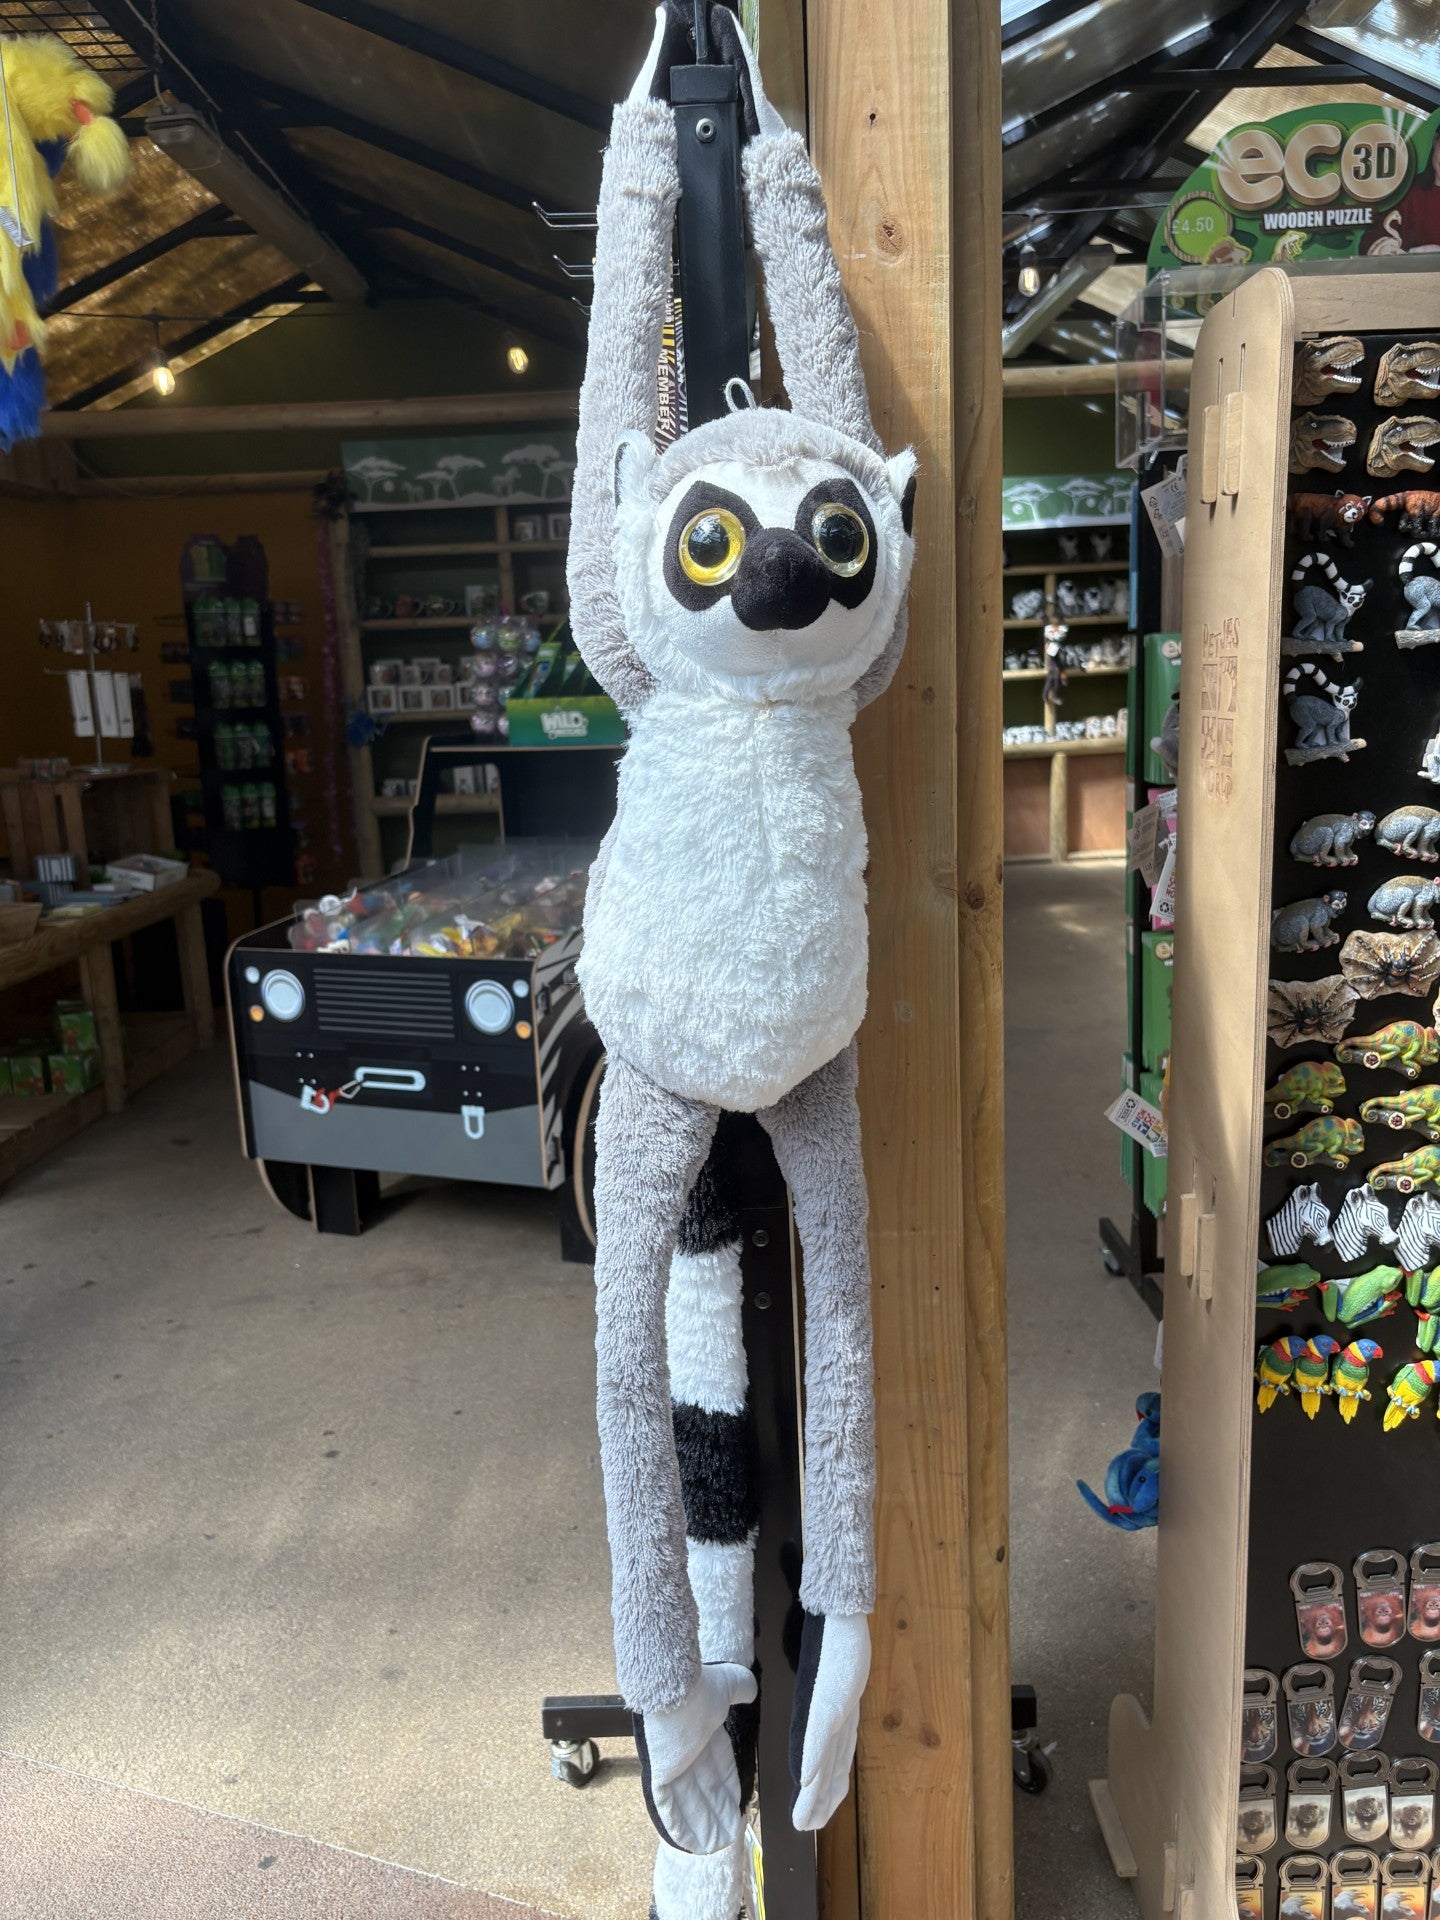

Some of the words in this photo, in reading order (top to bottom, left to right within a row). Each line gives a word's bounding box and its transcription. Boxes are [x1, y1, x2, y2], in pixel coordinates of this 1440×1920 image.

[1352, 142, 1398, 182] 3D
[1171, 216, 1215, 235] £4.50
[1263, 210, 1325, 230] WOODEN
[1326, 207, 1373, 226] PUZZLE
